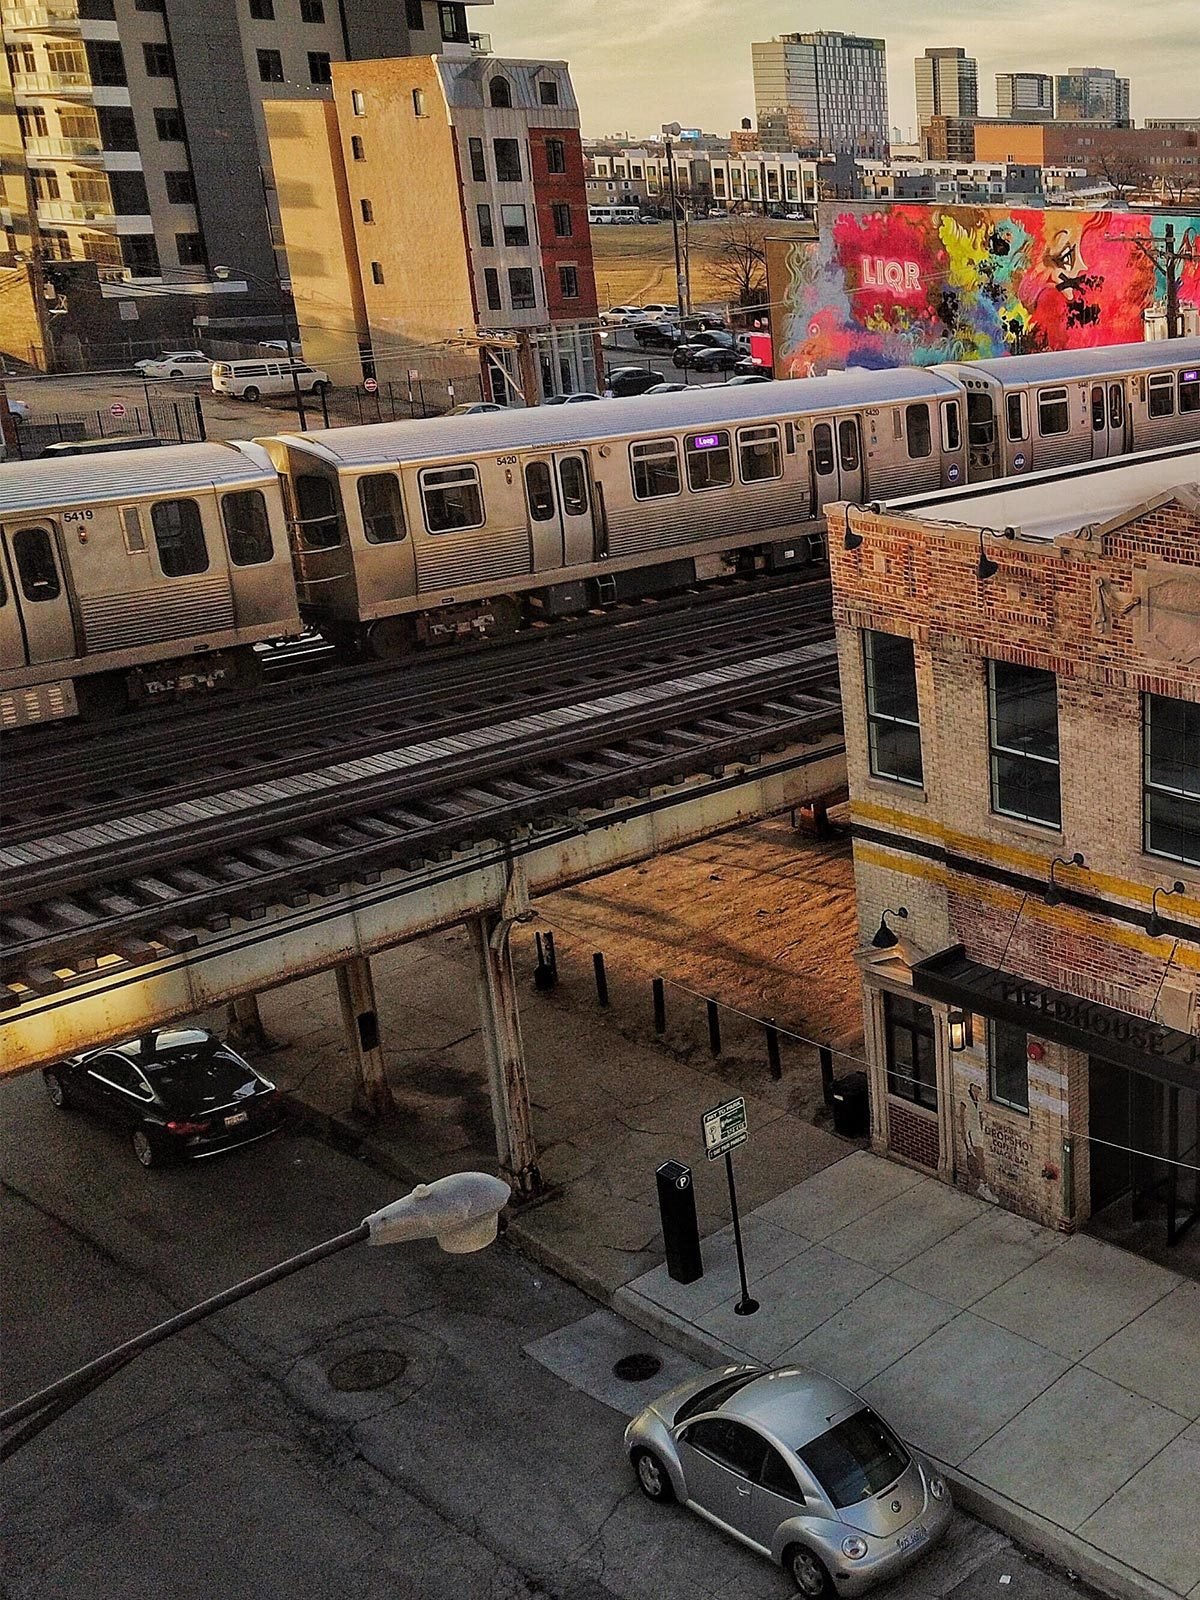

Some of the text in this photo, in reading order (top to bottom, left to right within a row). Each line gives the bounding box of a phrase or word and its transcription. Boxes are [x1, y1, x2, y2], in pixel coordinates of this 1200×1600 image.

[862, 258, 922, 293] LIQR
[698, 437, 715, 446] Loop
[496, 456, 517, 466] 5420
[63, 510, 93, 523] 5419
[998, 979, 1167, 1056] FIELDHOUSE
